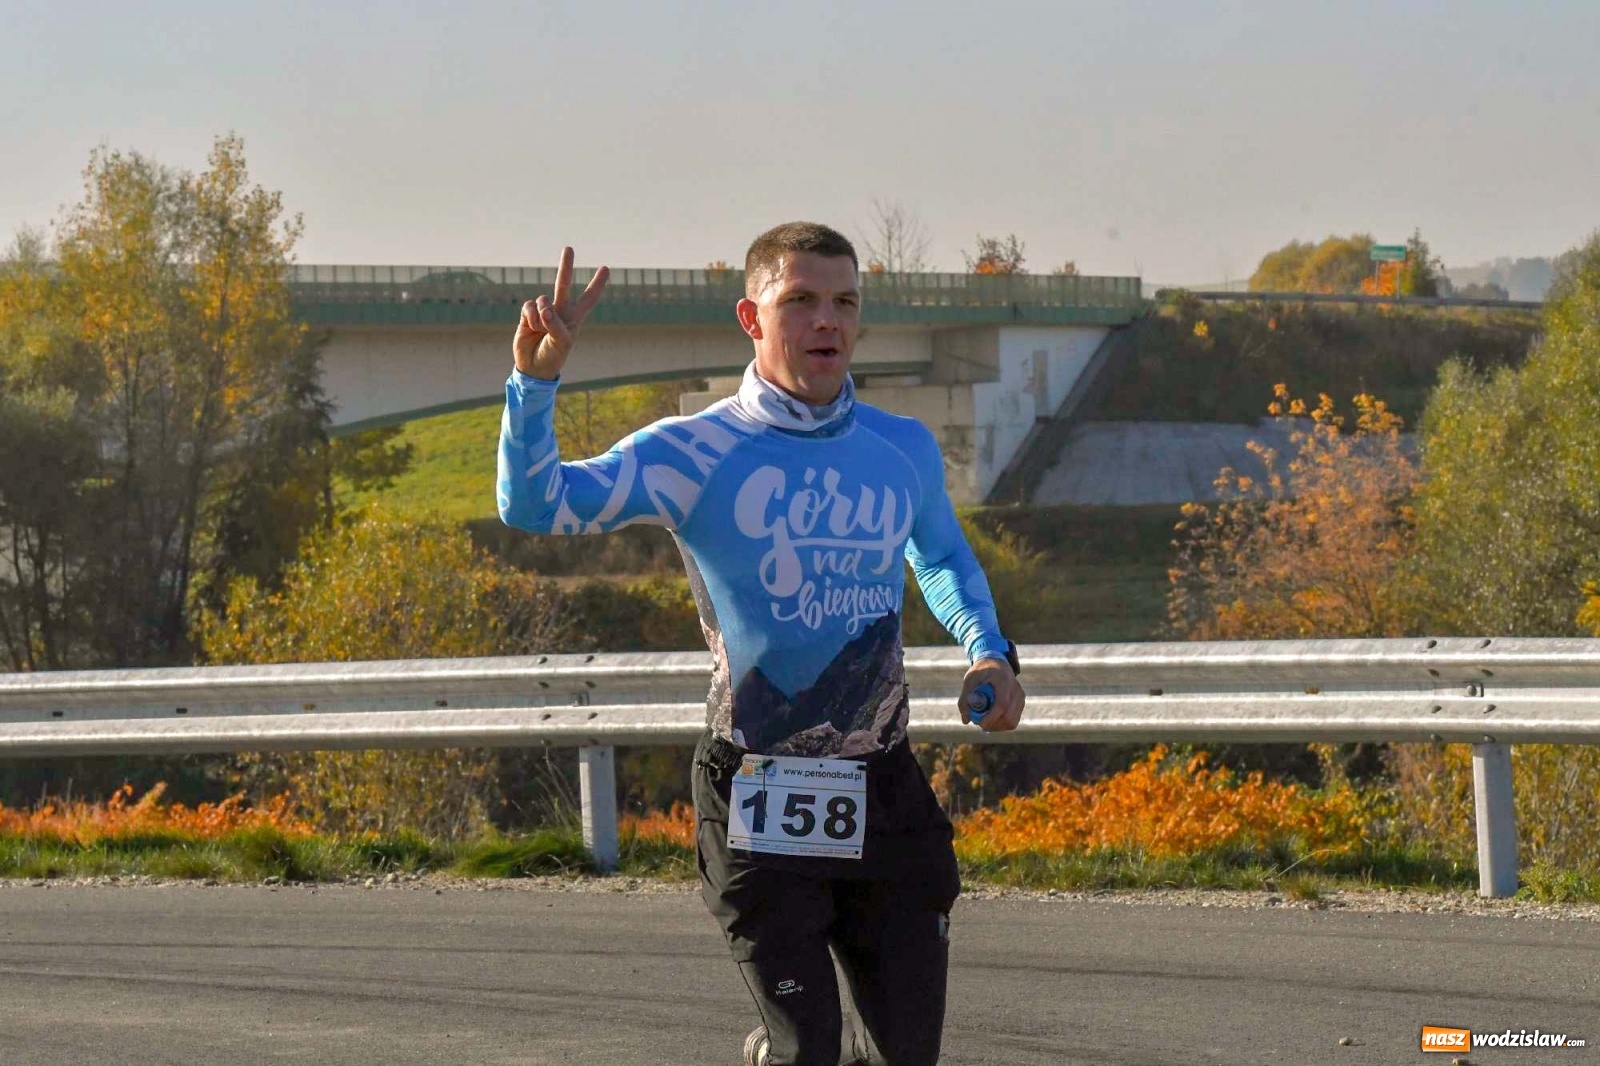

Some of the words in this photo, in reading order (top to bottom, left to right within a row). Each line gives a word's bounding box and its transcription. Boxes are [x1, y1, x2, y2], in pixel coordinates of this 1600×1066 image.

[813, 550, 862, 580] na
[783, 768, 862, 782] www.personalbest.pl
[742, 790, 857, 840] 158
